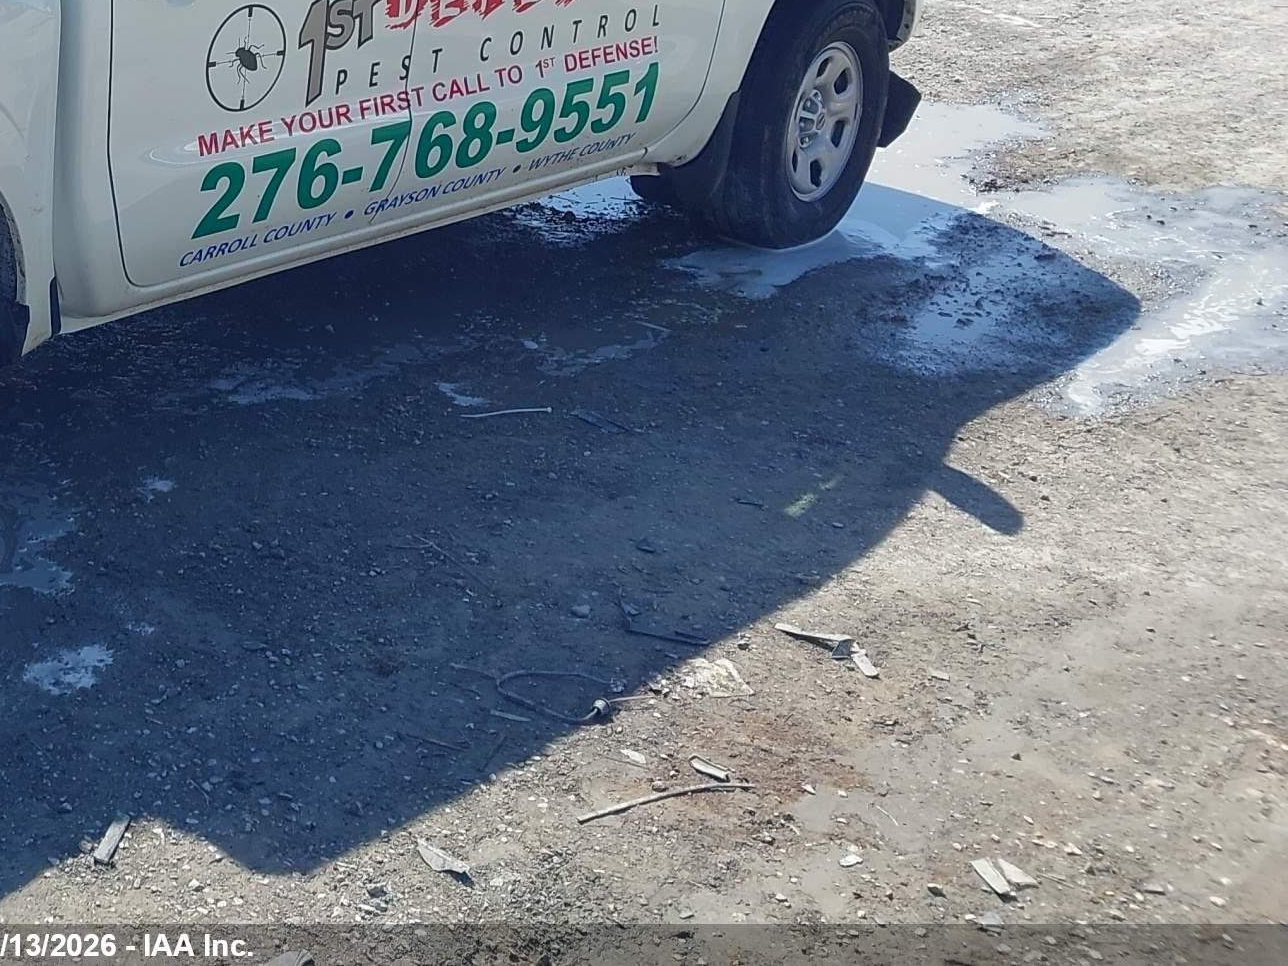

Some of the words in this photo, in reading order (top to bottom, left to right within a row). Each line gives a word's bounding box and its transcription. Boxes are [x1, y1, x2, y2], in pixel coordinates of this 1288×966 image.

[198, 121, 274, 156] MAKE
[281, 104, 351, 136] YOUR
[359, 87, 425, 120] FIRST
[432, 74, 490, 102] CALL
[494, 65, 523, 87] TO
[564, 36, 659, 72] DEFENSE!
[336, 47, 443, 95] PEST
[480, 4, 660, 62] CONTROL
[179, 235, 258, 267] CARROLL
[263, 212, 338, 244] COUNTY
[364, 185, 440, 216] GRAYSON
[442, 166, 506, 195] COUNTY
[528, 148, 580, 171] WYTHE
[579, 132, 636, 158] COUNTY
[191, 62, 659, 240] 276-768-9551
